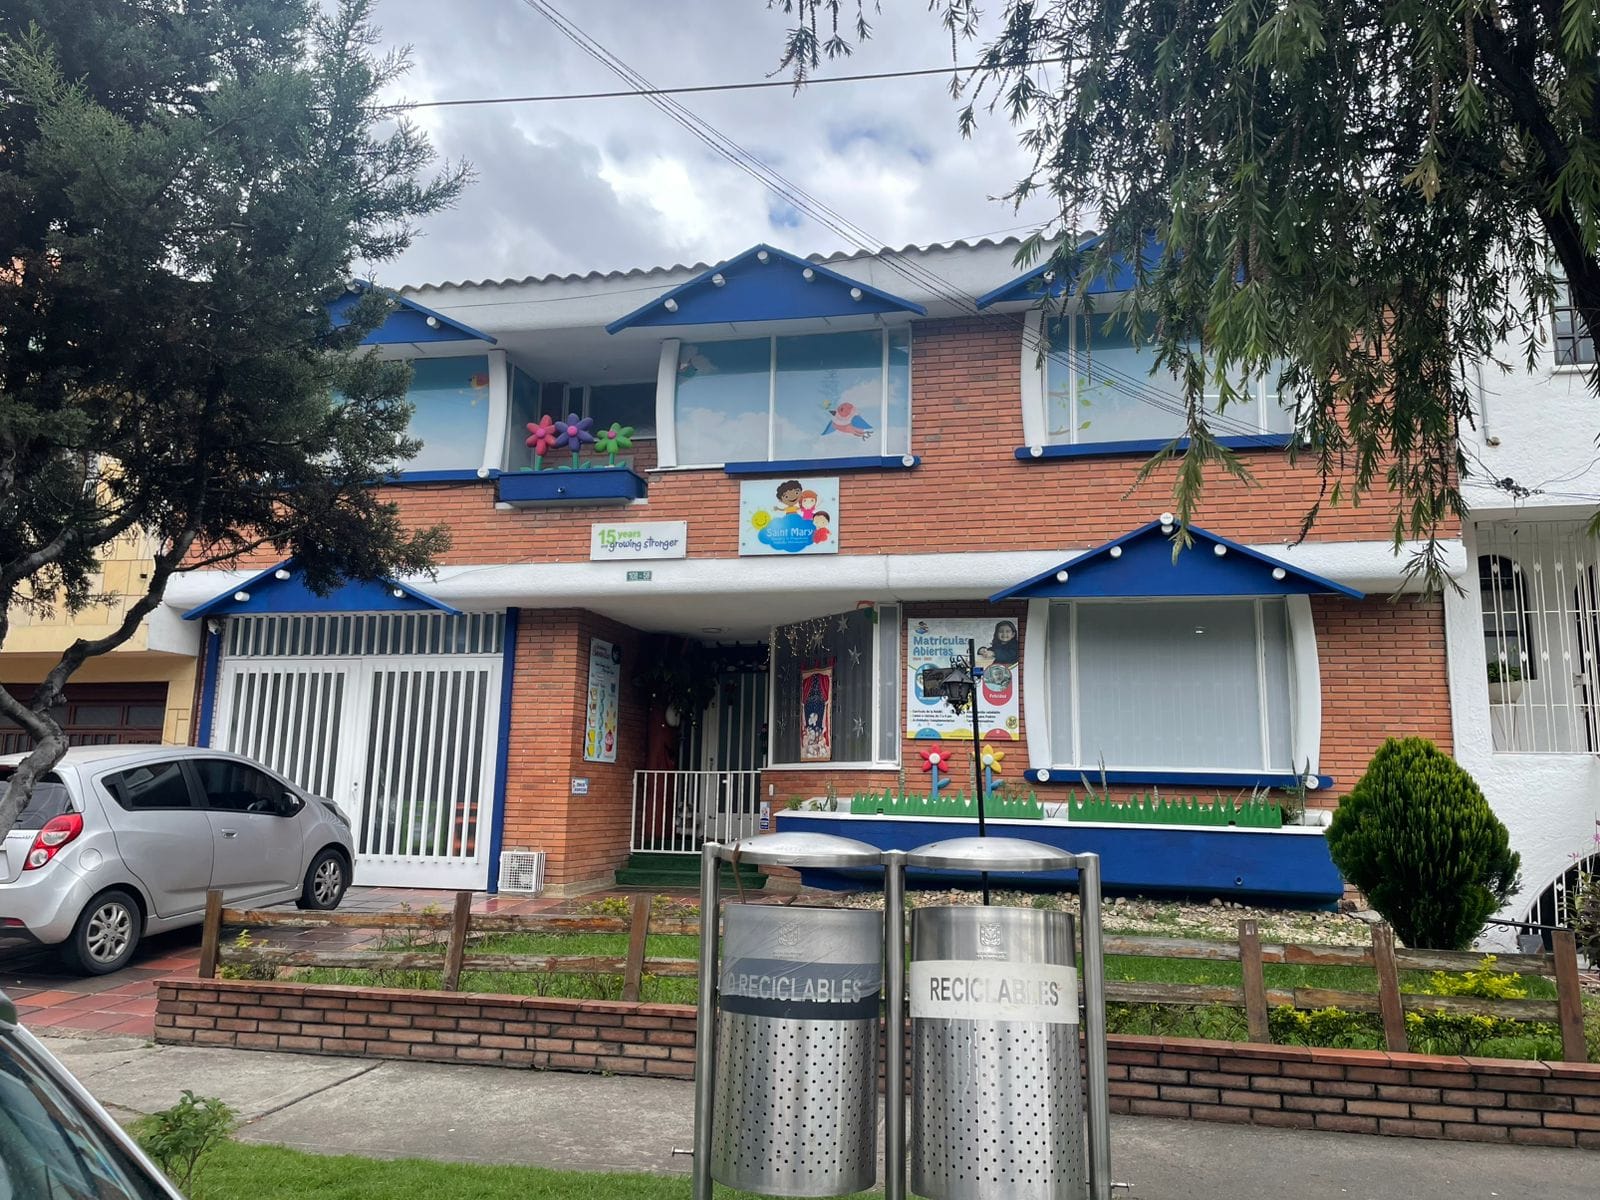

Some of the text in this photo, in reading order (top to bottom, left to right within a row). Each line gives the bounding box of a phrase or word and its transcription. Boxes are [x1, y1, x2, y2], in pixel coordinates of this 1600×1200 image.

[598, 529, 641, 545] 15 years
[766, 527, 813, 537] Saint Mary
[608, 539, 642, 552] growing
[643, 536, 679, 551] stronger
[913, 646, 954, 656] Abiertas
[738, 974, 863, 1003] RECICLABLES
[930, 976, 1059, 1006] RECICLABLES
